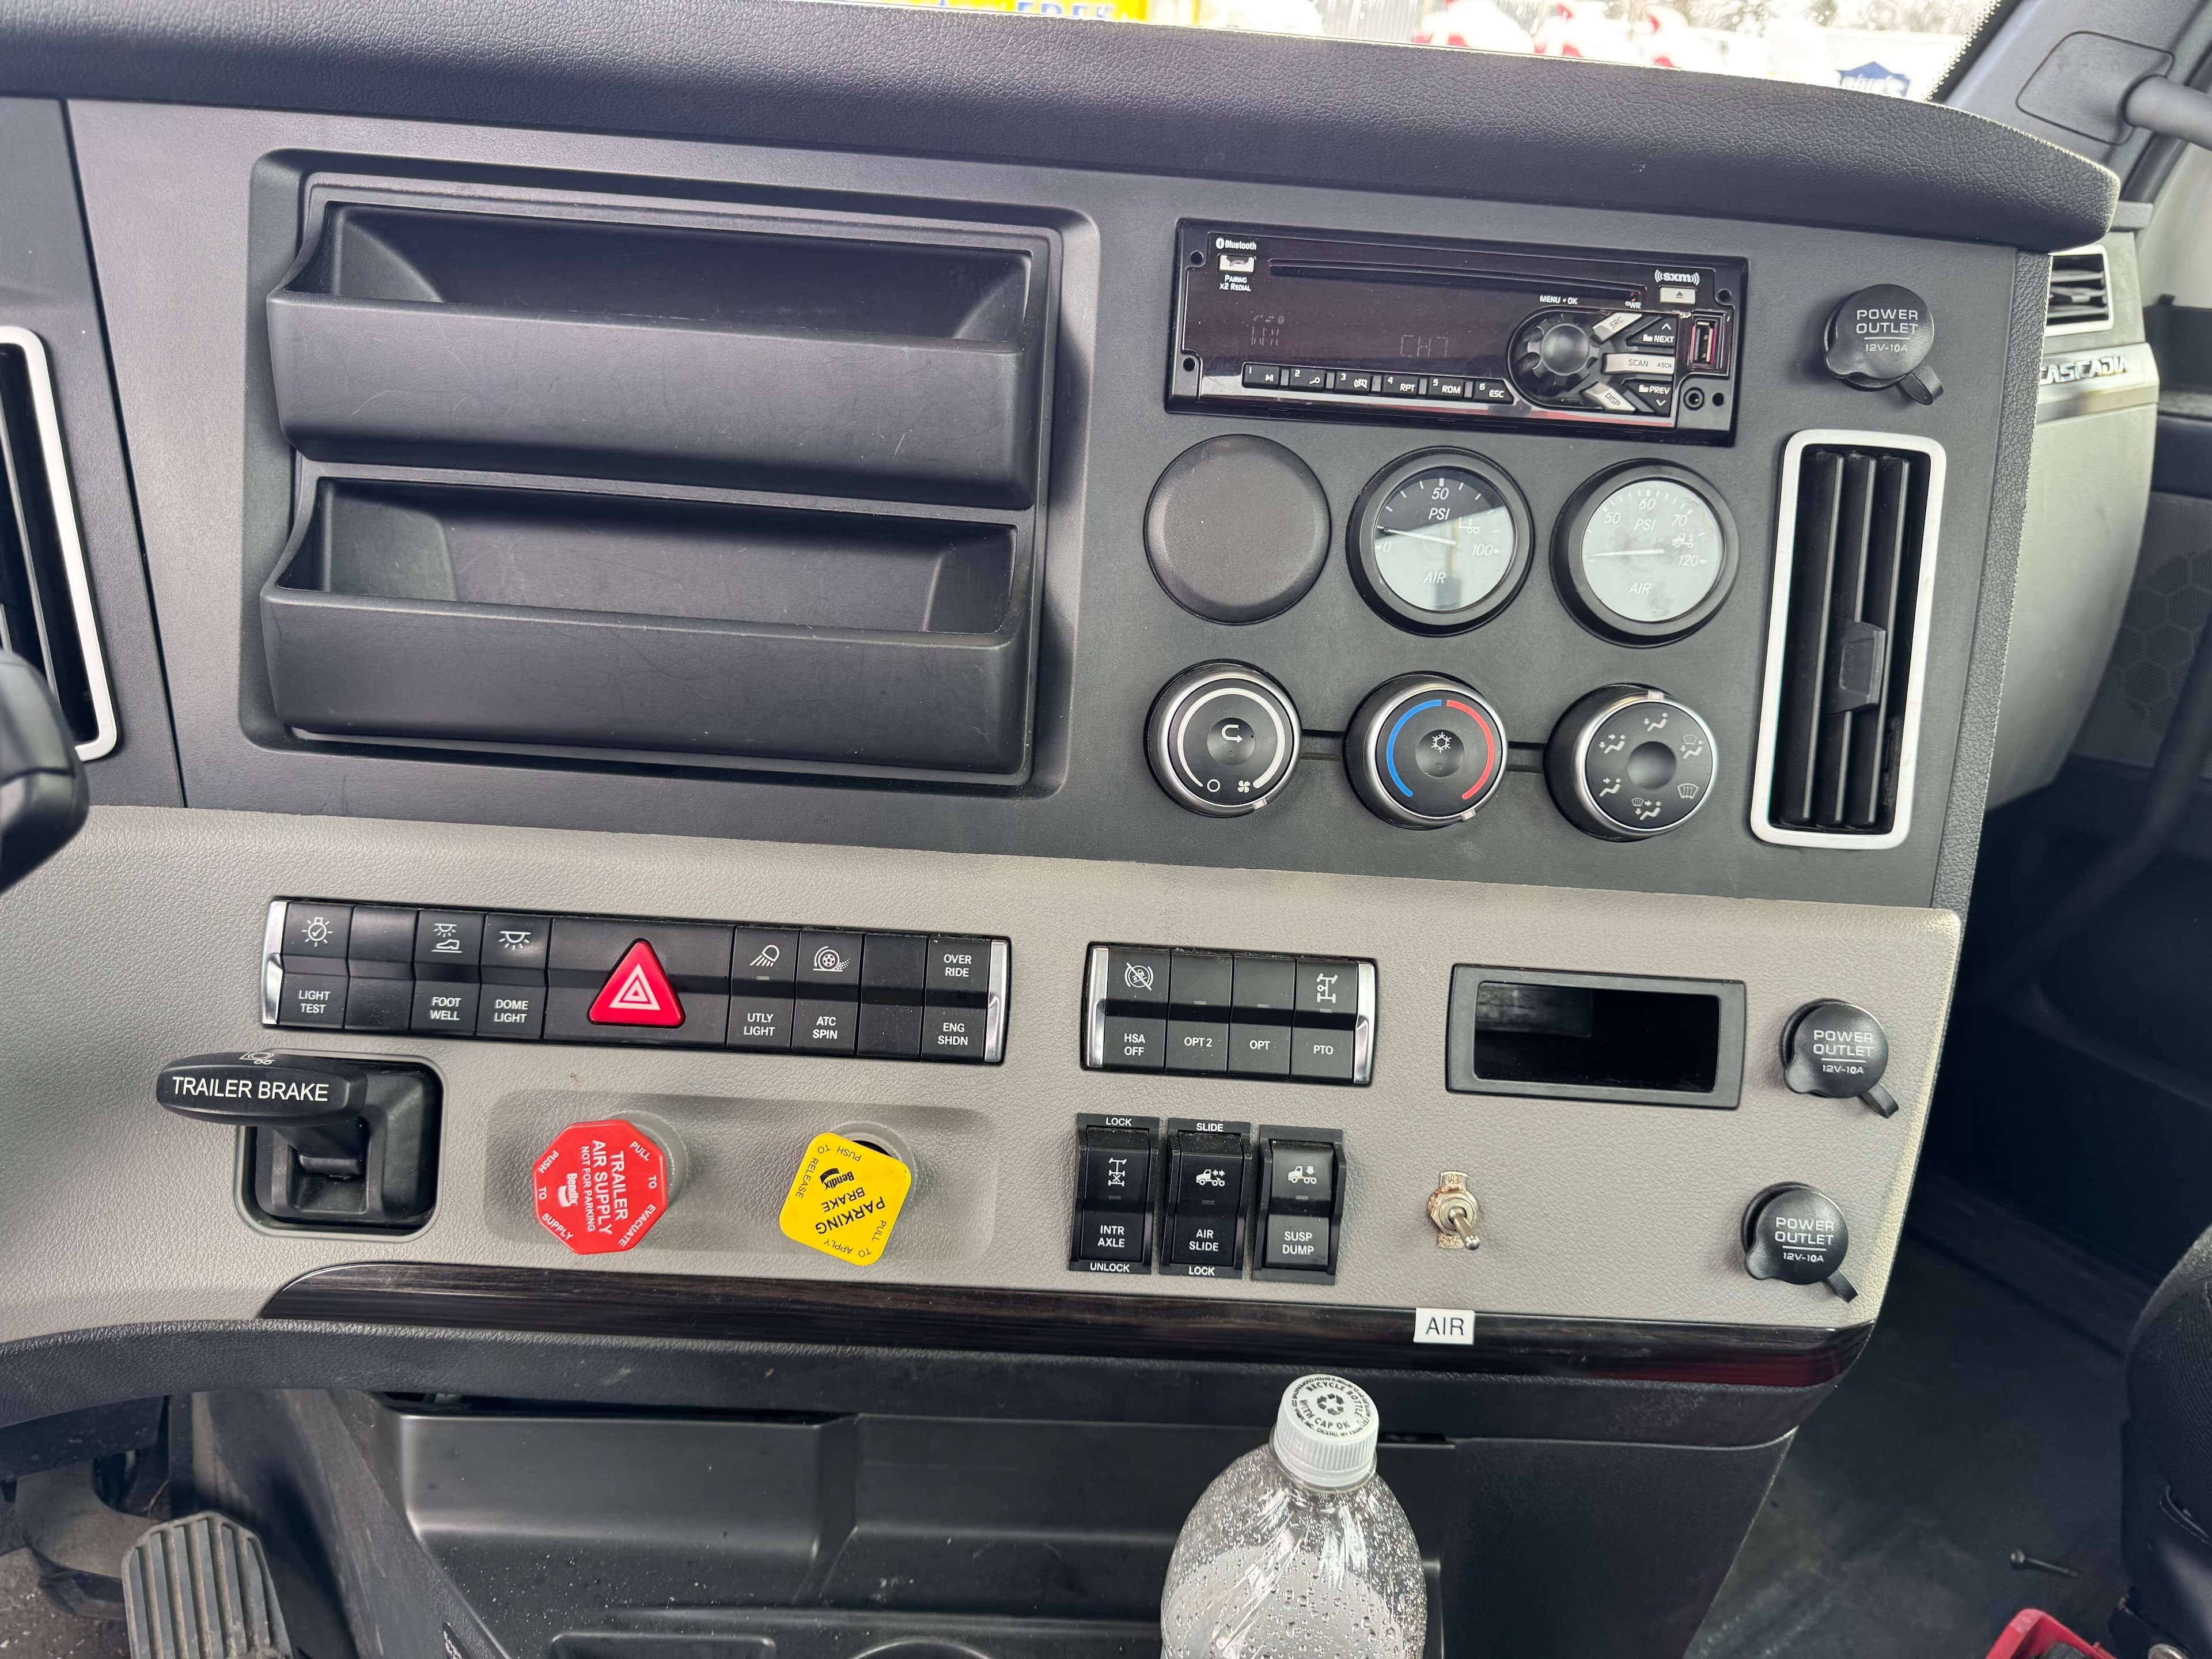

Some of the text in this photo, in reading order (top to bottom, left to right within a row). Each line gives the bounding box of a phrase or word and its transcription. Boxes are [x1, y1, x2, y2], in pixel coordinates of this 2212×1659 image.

[1225, 240, 1256, 250] Bluetooth
[1540, 295, 1560, 304] MENU
[1856, 309, 1918, 320] POWER
[1609, 316, 1623, 329] SRC
[1856, 323, 1918, 334] OUTLET
[1865, 343, 1908, 353] 12V-10A
[1249, 366, 1252, 374] 1
[1400, 383, 1415, 392] RPT
[1649, 386, 1670, 394] PREV
[1489, 390, 1505, 398] ESC
[1605, 393, 1620, 406] DISP
[1431, 488, 1449, 500] 50
[1639, 498, 1656, 510] 60
[1429, 508, 1450, 520] PSI
[1604, 512, 1621, 524] 50
[1634, 519, 1655, 531] PSI
[1671, 514, 1687, 526] 70
[1382, 541, 1391, 552] 0
[1472, 544, 1493, 556] 100
[1679, 555, 1699, 566] 120
[1423, 571, 1446, 584] AIR
[1628, 583, 1651, 595] AIR
[944, 955, 972, 965] OVER
[945, 967, 969, 978] RIDE
[298, 990, 330, 1001] LIGHT
[431, 996, 461, 1007] FOOT
[495, 999, 529, 1010] DOME
[300, 1003, 326, 1014] TEST
[430, 1009, 460, 1021] WELL
[494, 1012, 527, 1023] LIGHT
[747, 1013, 774, 1024] UTLY
[816, 1016, 837, 1026] ATC
[744, 1025, 775, 1037] LIGHT
[943, 1022, 965, 1033] ENG
[812, 1029, 838, 1039] SPIN
[1124, 1034, 1145, 1044] HSA
[1813, 1030, 1873, 1043] POWER
[938, 1035, 968, 1046] SHDN
[1184, 1037, 1213, 1047] OPT 2
[1249, 1040, 1271, 1050] OPT
[1124, 1047, 1145, 1056] OFF
[1313, 1046, 1334, 1055] PTO
[1813, 1044, 1874, 1056] OUTLET
[1822, 1065, 1864, 1074] 12V-10A
[172, 1077, 329, 1101] TRAILER BRAKE
[1105, 1117, 1132, 1127] LOCK
[1196, 1122, 1224, 1132] SLIDE
[796, 1144, 862, 1199] PUSH TO RELEASE
[609, 1150, 628, 1221] TRAILER
[824, 1171, 855, 1190] Bendix
[566, 1172, 578, 1206] Bendix
[581, 1146, 596, 1232] NOT FOR PARKING
[592, 1139, 613, 1235] AIR SUPPLY
[537, 1150, 574, 1241] PUSH TO SUPPLY
[618, 1141, 657, 1247] PULL TO EVACUATE
[821, 1187, 865, 1213] BRAKE
[815, 1196, 886, 1234] PARKING
[1775, 1217, 1834, 1231] POWER
[1100, 1225, 1124, 1236] INTR
[1196, 1229, 1214, 1239] AIR
[823, 1220, 887, 1258] PULL TO APPLY
[1284, 1231, 1313, 1242] SUSP
[1775, 1231, 1834, 1245] OUTLET
[1097, 1237, 1125, 1248] AXLE
[1189, 1241, 1219, 1252] SLIDE
[1282, 1244, 1315, 1255] DUMP
[1783, 1252, 1824, 1262] 12V-10A
[1090, 1262, 1130, 1273] UNLOCK
[1188, 1266, 1215, 1277] LOCK
[1426, 1317, 1464, 1335] AIR
[1305, 1381, 1363, 1416] RECYCLE BOTTLE
[1315, 1418, 1333, 1429] CAP
[1336, 1421, 1350, 1429] ON
